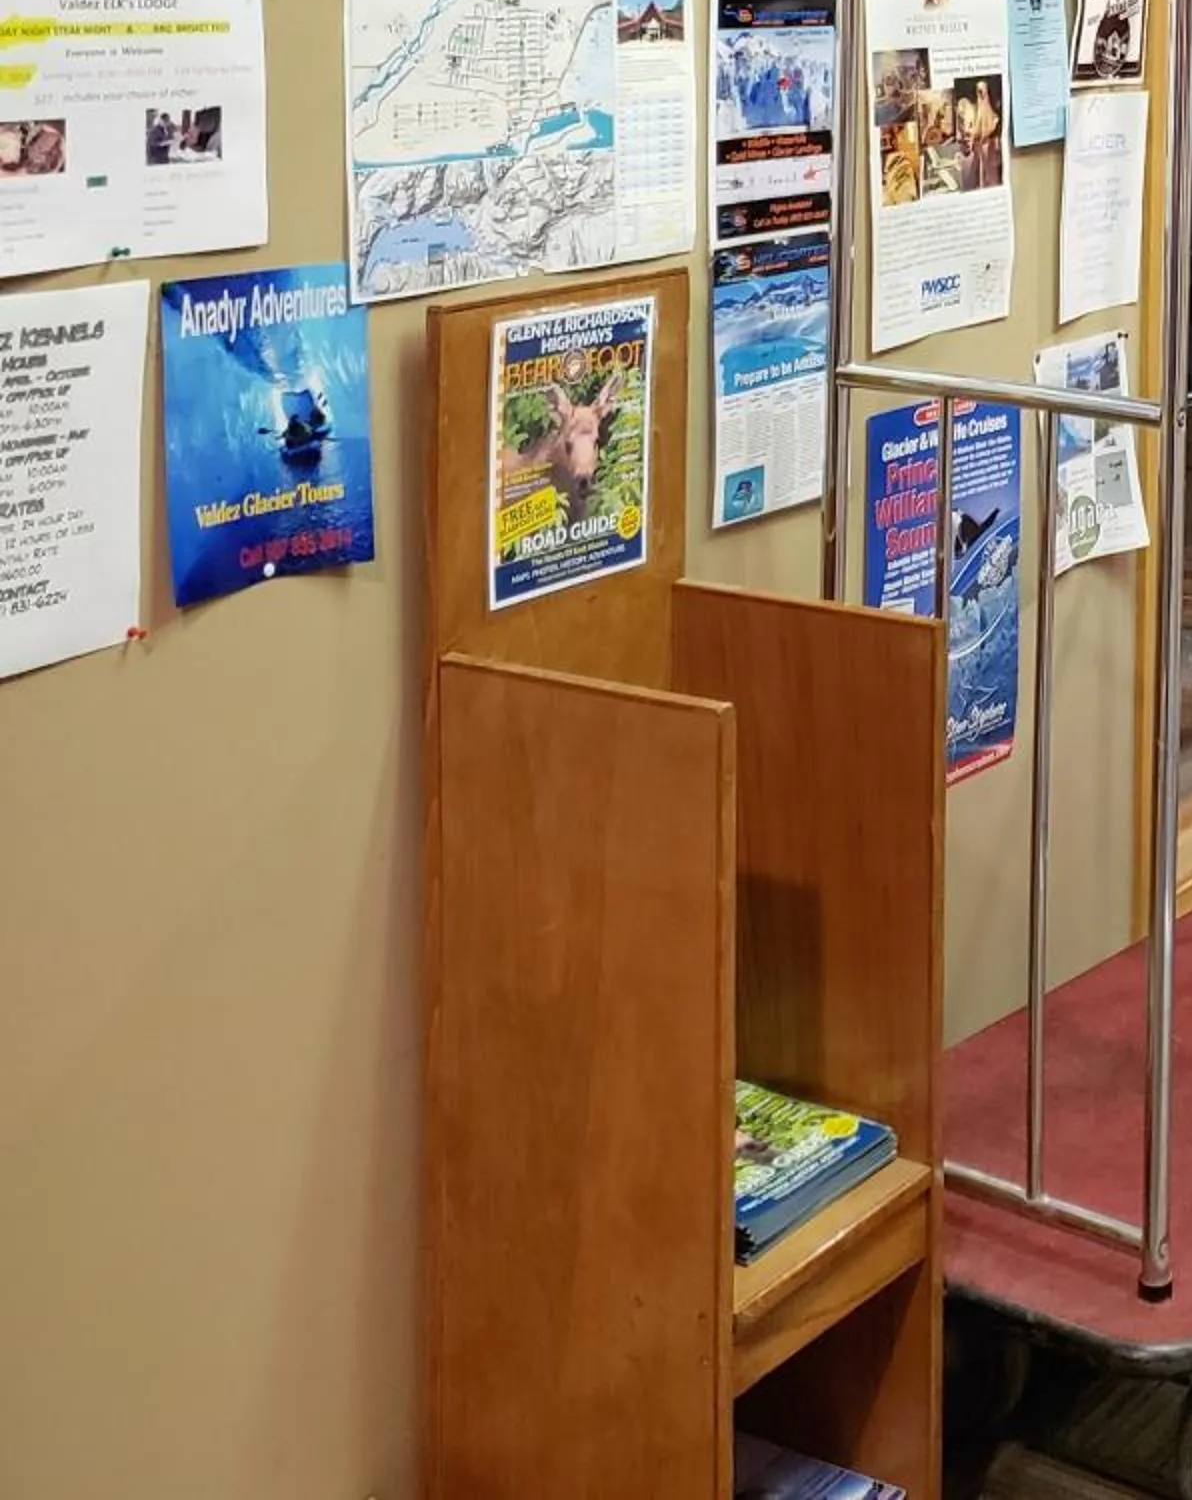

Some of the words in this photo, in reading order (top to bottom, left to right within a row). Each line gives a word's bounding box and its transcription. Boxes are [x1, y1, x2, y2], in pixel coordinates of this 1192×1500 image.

[20, 319, 104, 350] KENNELS
[180, 288, 247, 344] Anadyr
[249, 282, 348, 328] Adventures
[507, 323, 552, 344] GLENN
[553, 320, 563, 335] &
[564, 303, 648, 334] RICHARDSON
[541, 327, 615, 355] HIGHWAYS
[506, 357, 563, 388] BEAR
[585, 340, 645, 373] FOOT
[882, 436, 919, 463] Glacier
[919, 431, 929, 451] &
[968, 413, 1008, 437] Cruises
[196, 499, 242, 530] Valdez
[242, 485, 297, 519] Glacier
[297, 479, 345, 509] Tours
[521, 526, 567, 554] ROAD
[569, 512, 619, 542] GUIDE
